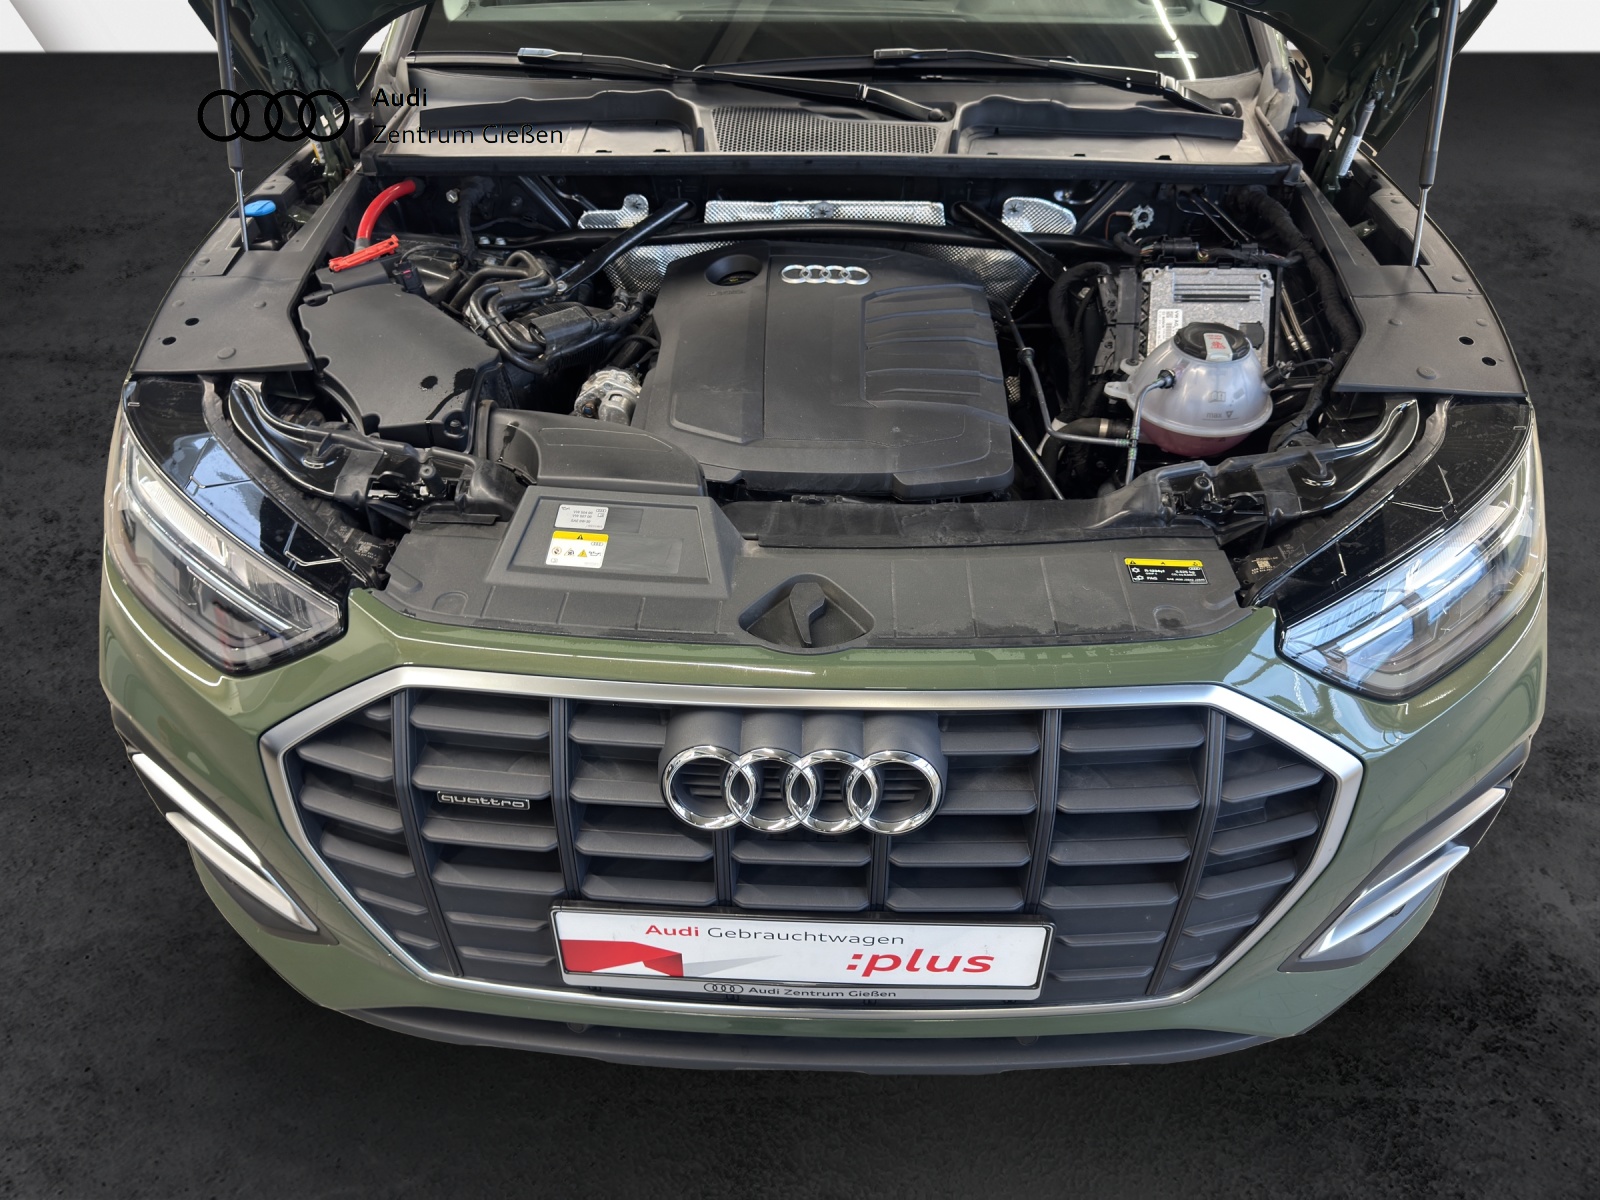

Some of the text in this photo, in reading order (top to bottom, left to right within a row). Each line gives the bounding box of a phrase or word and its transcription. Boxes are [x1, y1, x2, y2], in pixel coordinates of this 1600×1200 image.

[441, 794, 525, 808] quattro
[645, 924, 904, 947] Audi Gebrauchtwagen
[846, 948, 995, 978] :plus
[748, 987, 780, 995] Audi
[784, 988, 844, 997] Zentrum
